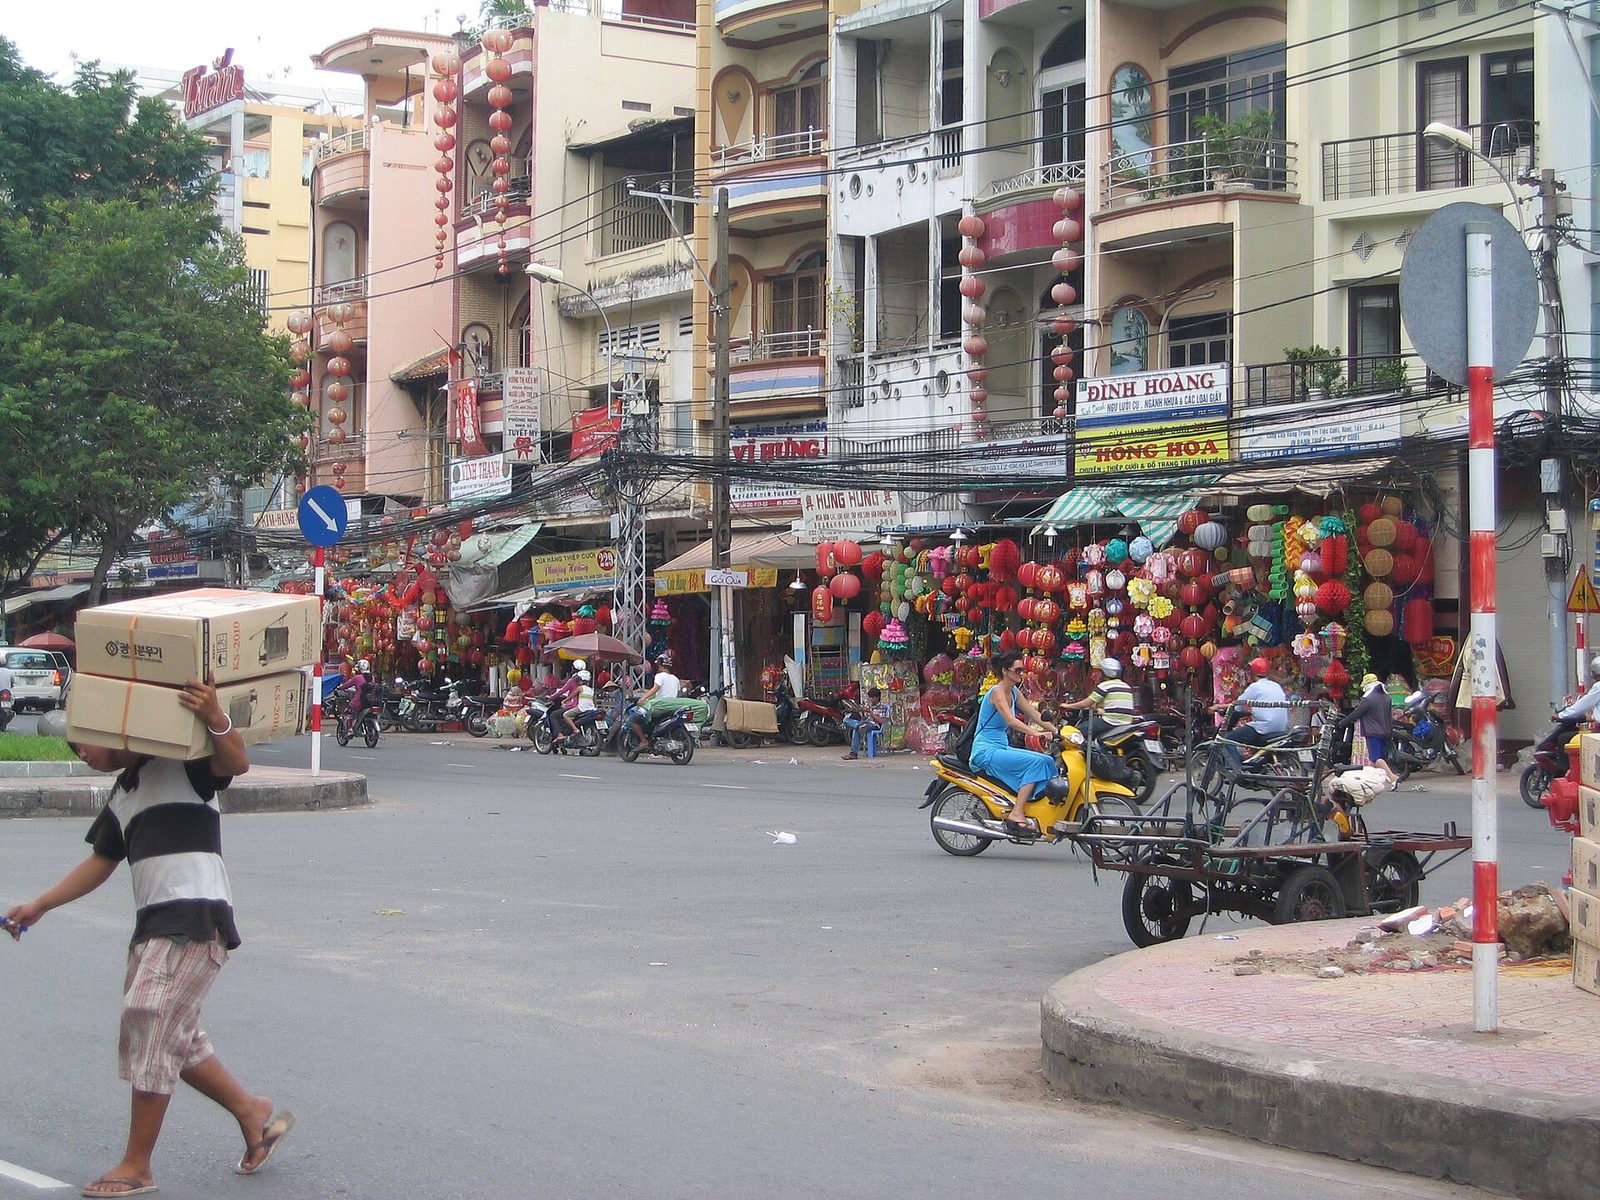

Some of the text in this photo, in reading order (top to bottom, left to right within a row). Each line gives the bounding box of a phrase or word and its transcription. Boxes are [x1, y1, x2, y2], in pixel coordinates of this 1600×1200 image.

[1088, 379, 1137, 402] ĐÌNH
[1144, 371, 1216, 396] HOÀNG
[1166, 439, 1219, 457] HOA
[1158, 459, 1178, 468] TRANG
[598, 552, 615, 567] 229
[232, 620, 240, 671] KS-2010
[272, 684, 281, 732] KS-2010
